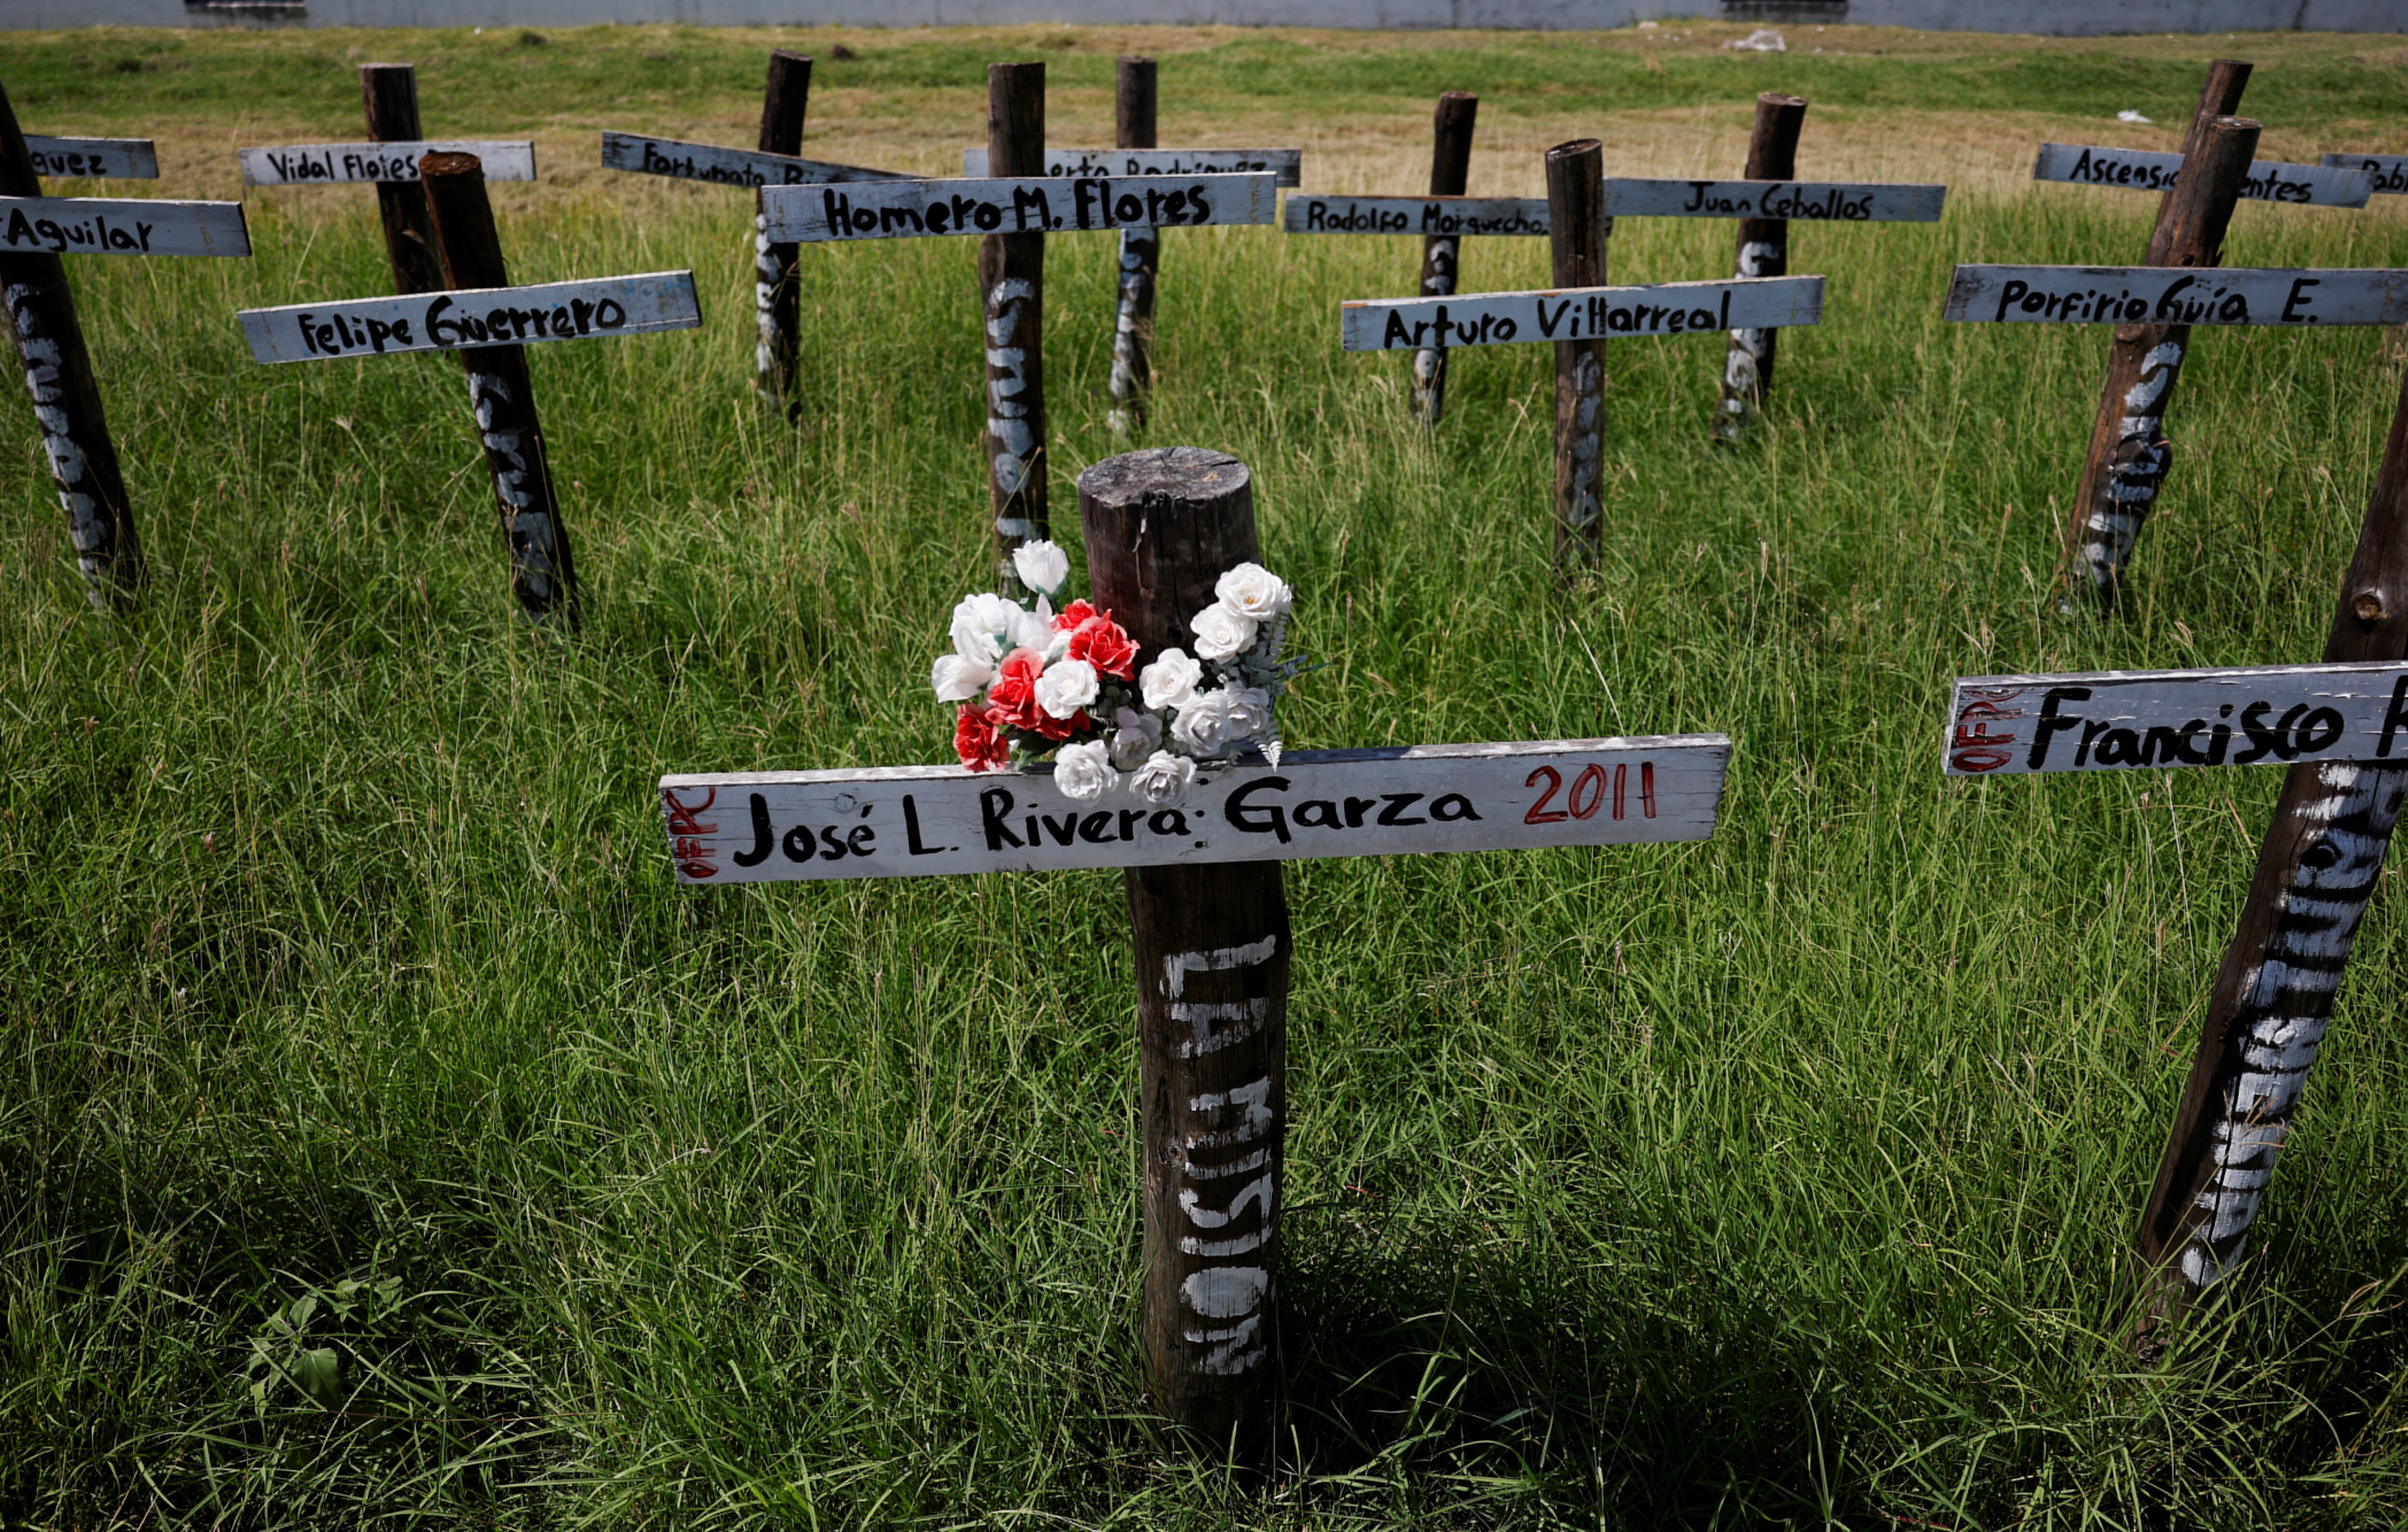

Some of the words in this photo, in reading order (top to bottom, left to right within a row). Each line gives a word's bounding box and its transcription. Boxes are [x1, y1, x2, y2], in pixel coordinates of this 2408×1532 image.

[267, 150, 335, 182] Vidal
[343, 154, 419, 180] Flores
[2238, 169, 2313, 203] entes
[823, 187, 1002, 236] Homero
[1012, 184, 1065, 231] M.
[1073, 178, 1211, 229] Flores
[1308, 201, 1408, 233] Rodolfo
[1685, 181, 1751, 213] Juan
[1760, 183, 1874, 220] Ceballos
[6, 208, 154, 252] Aguilar
[1383, 304, 1517, 350] Arturo
[1537, 290, 1731, 338] Villarreal
[1995, 280, 2148, 323] Porfirio
[2281, 277, 2321, 323] E.
[297, 312, 414, 355] Felipe
[2027, 686, 2345, 770] Francisco
[732, 792, 877, 867] José
[902, 794, 959, 856] L.
[980, 786, 1192, 852] Rivera
[1223, 775, 1482, 845] Garza
[1524, 761, 1657, 825] 2011
